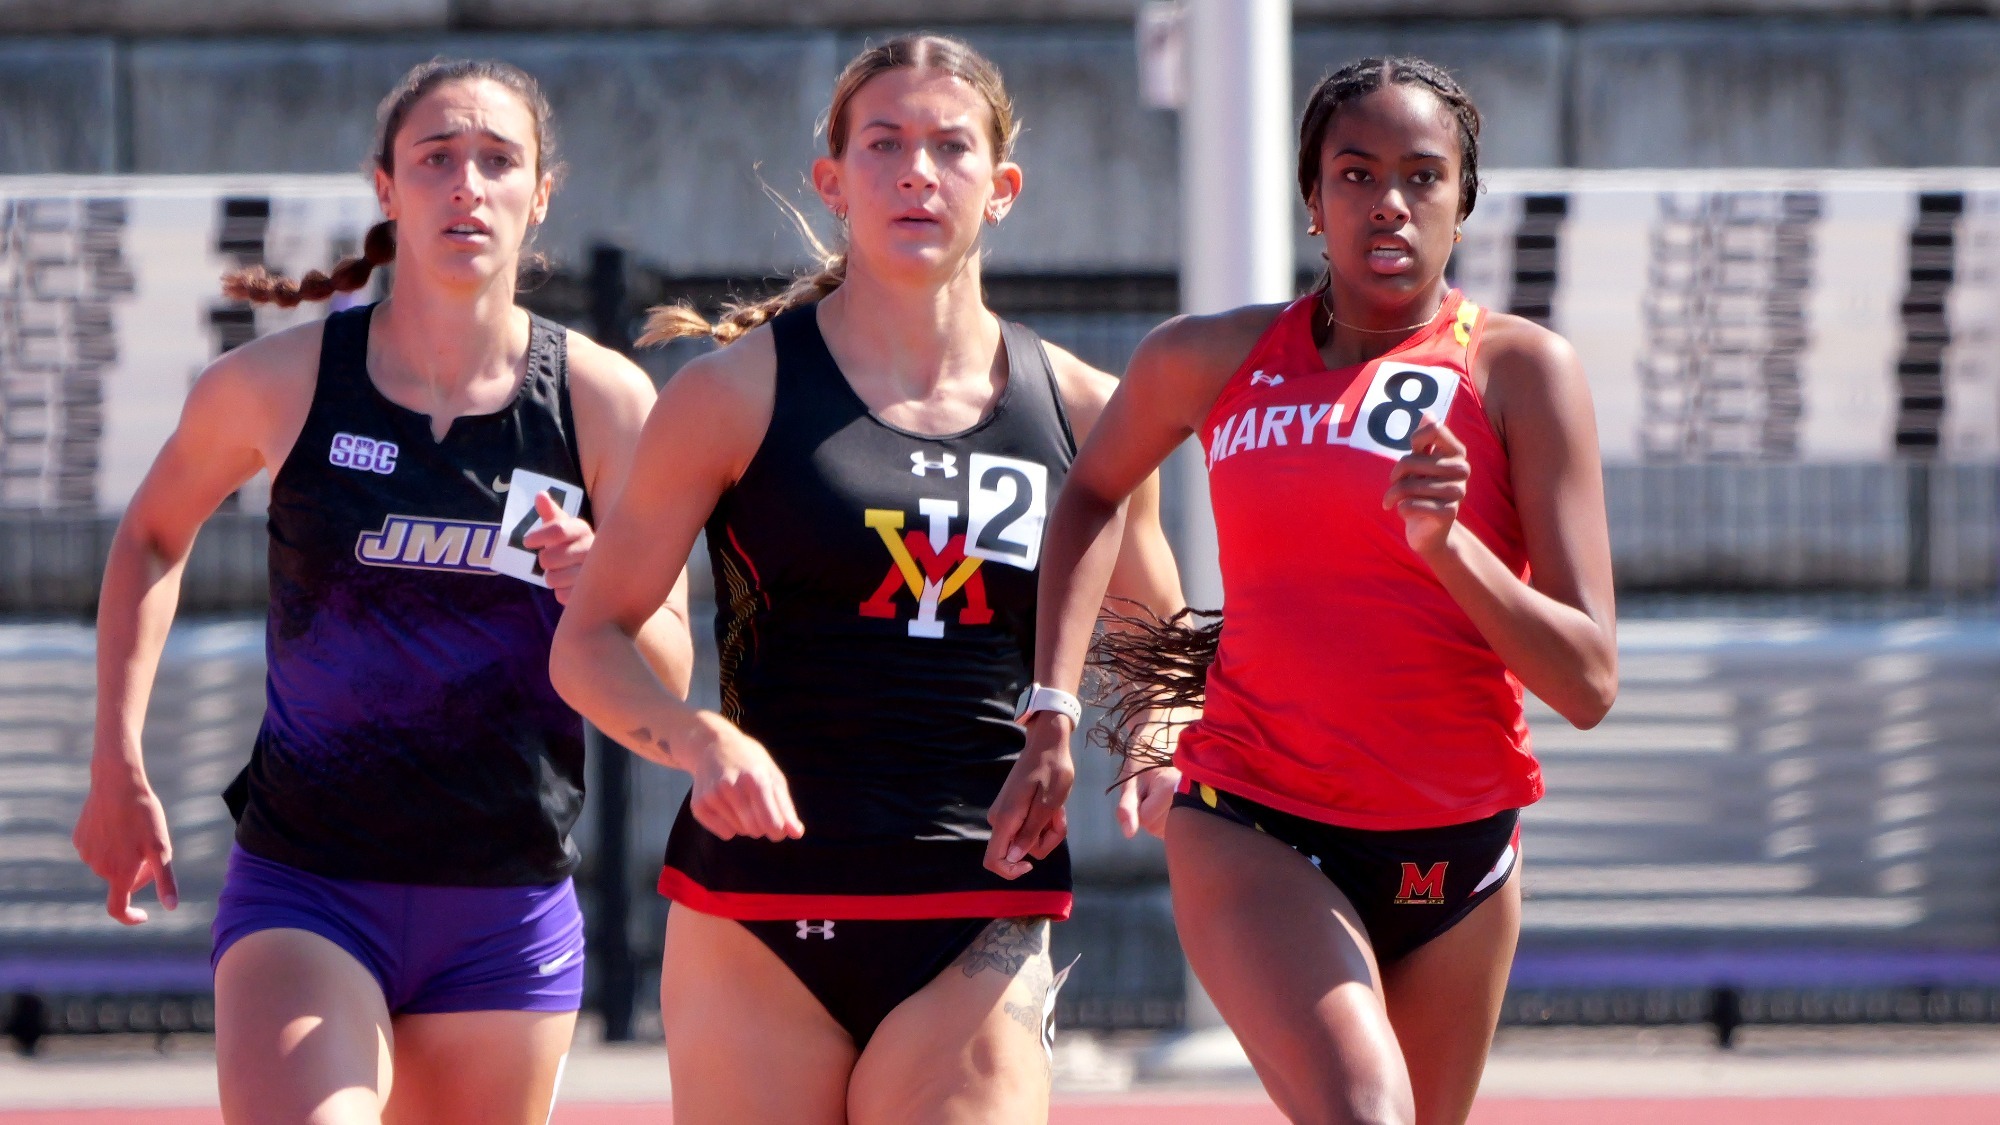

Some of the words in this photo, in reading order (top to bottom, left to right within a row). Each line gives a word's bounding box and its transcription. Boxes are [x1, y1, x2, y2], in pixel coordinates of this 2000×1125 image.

[1209, 403, 1353, 472] MARYL
[1367, 371, 1439, 451] 8
[330, 433, 398, 474] SBC
[975, 466, 1033, 560] 2
[362, 521, 500, 566] JMU
[1395, 861, 1450, 899] M
